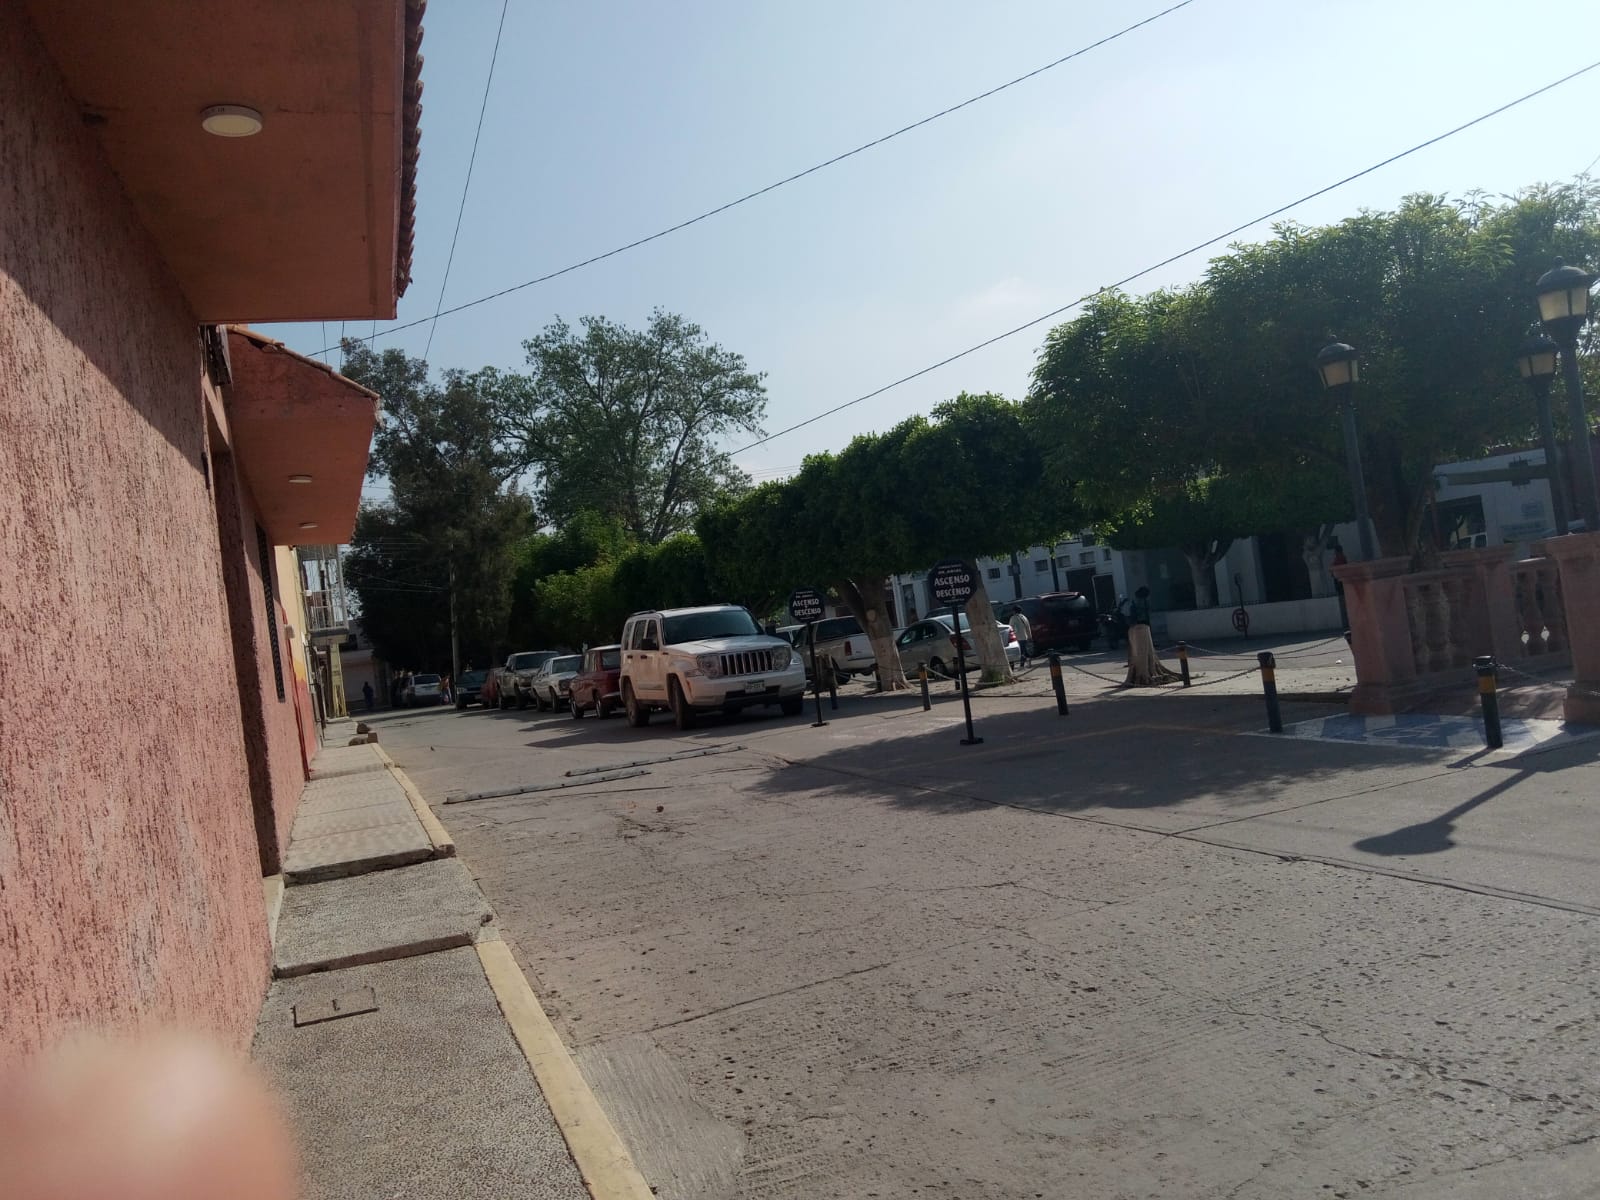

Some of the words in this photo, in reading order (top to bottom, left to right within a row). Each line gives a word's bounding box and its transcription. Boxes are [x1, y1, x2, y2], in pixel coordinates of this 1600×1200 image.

[934, 574, 970, 586] ASCENSO
[935, 586, 971, 598] DESCENSO
[792, 598, 820, 607] ASCENSO
[794, 607, 822, 617] DESCENSO
